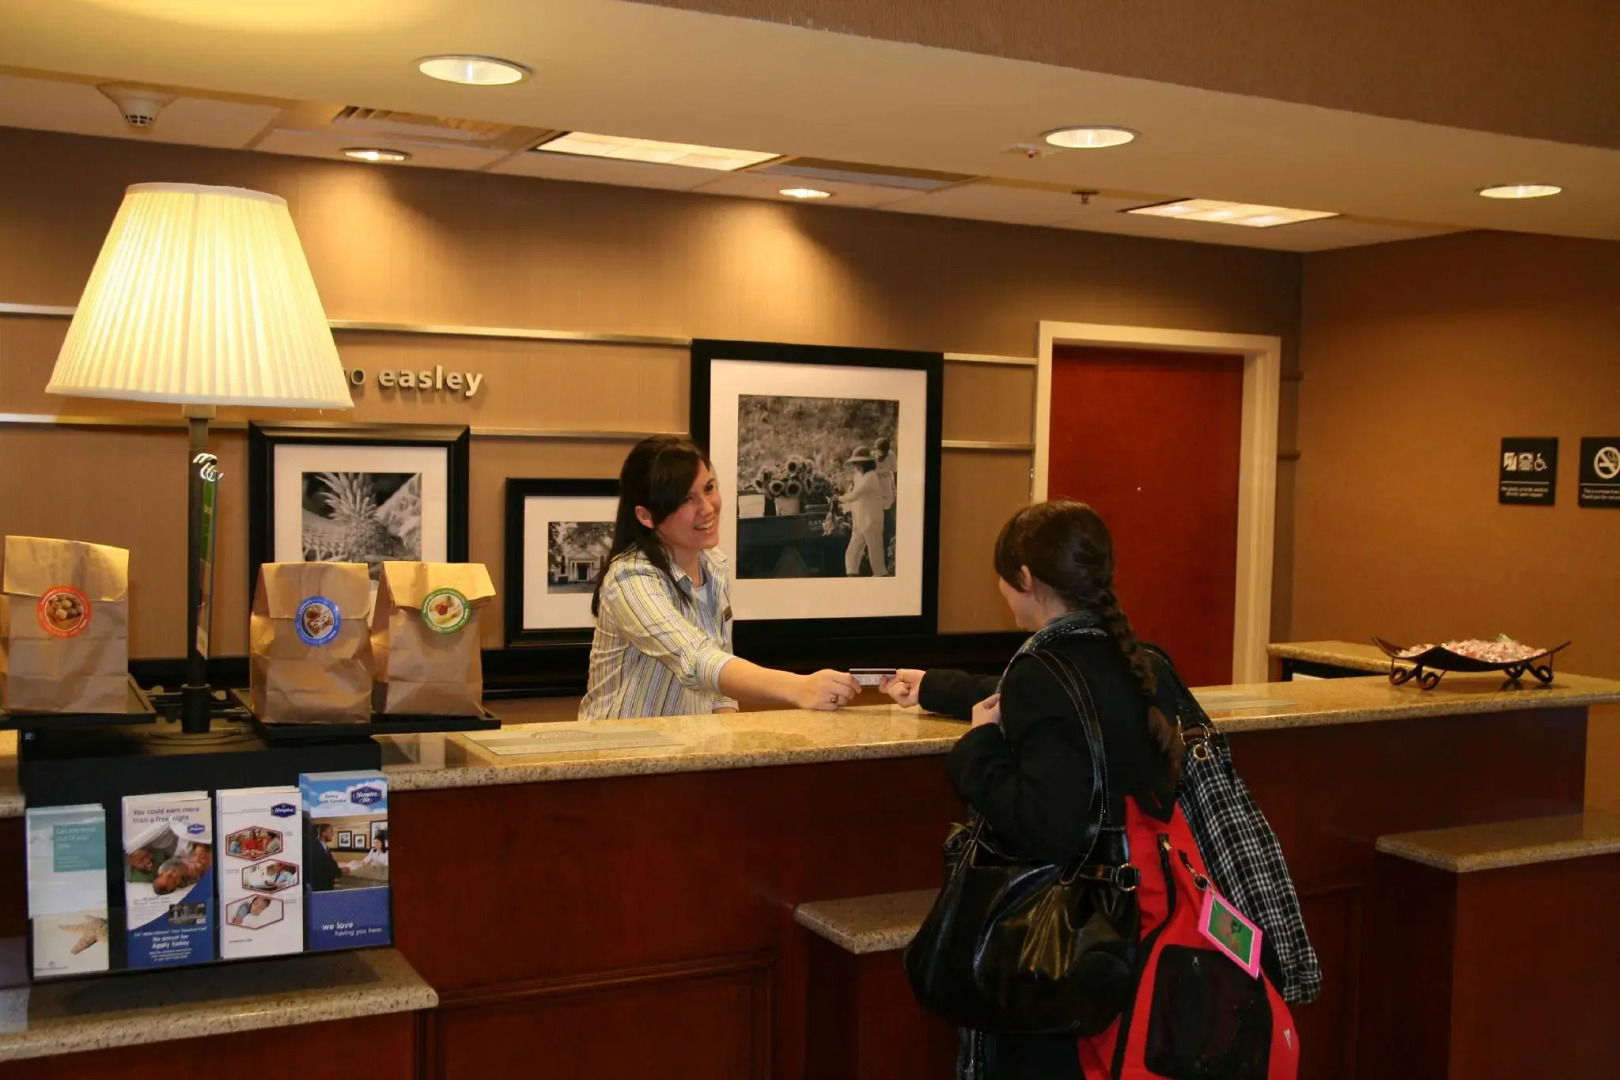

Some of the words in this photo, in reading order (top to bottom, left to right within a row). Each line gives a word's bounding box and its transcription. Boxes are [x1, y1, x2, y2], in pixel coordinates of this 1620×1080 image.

[378, 364, 483, 397] easley
[322, 923, 334, 931] we
[336, 921, 354, 930] love
[334, 929, 354, 937] having
